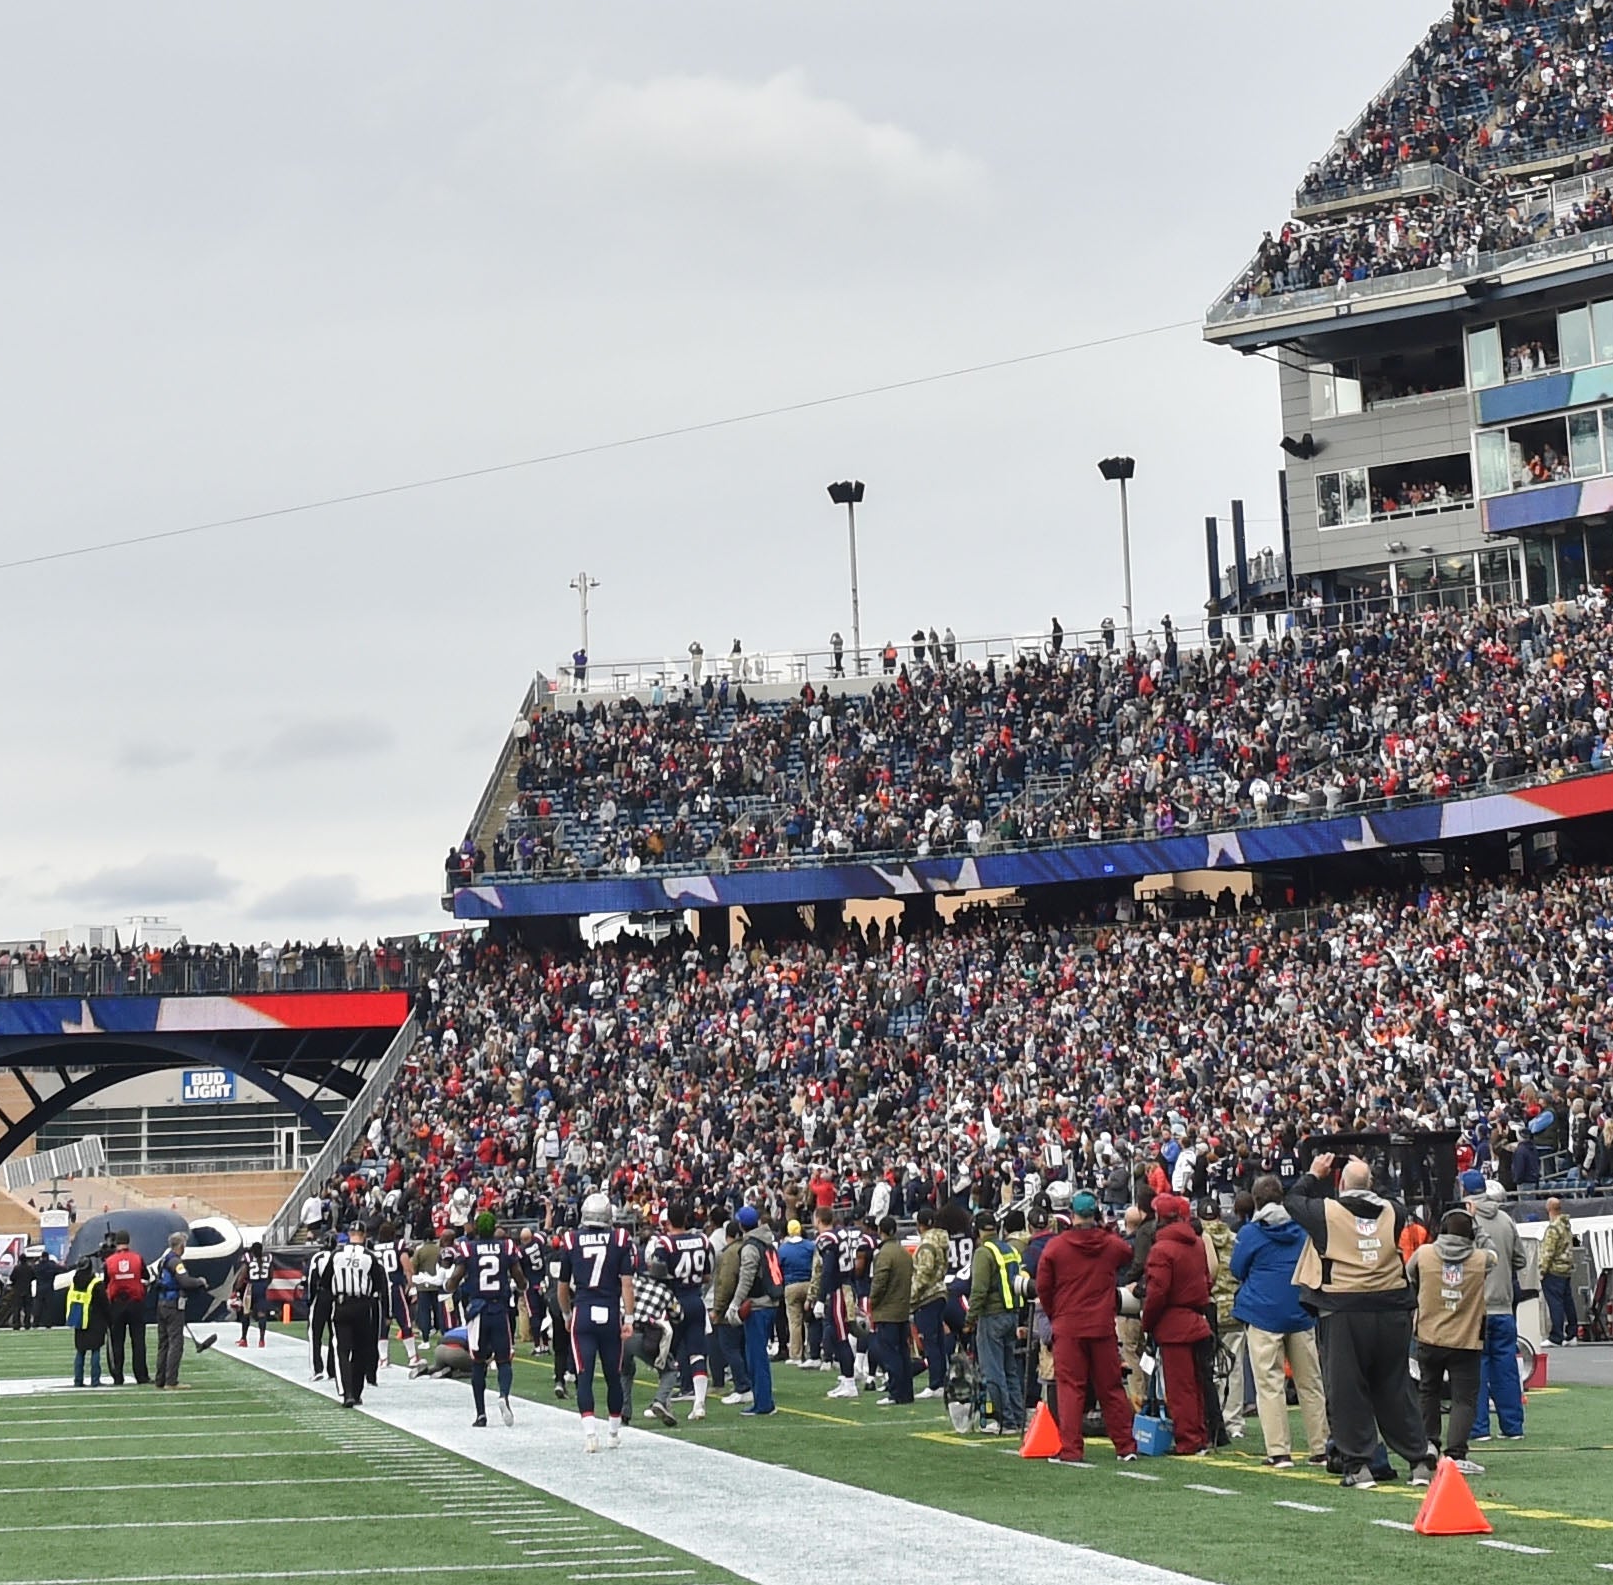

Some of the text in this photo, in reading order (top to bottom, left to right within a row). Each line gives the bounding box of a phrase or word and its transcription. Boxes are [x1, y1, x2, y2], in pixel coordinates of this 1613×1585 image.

[191, 1071, 226, 1086] BUD
[184, 1083, 233, 1099] LIGHT
[345, 1258, 360, 1267] 76
[582, 1245, 608, 1288] 7
[674, 1249, 706, 1284] 49
[479, 1256, 501, 1291] 2
[1445, 1271, 1461, 1283] NFL
